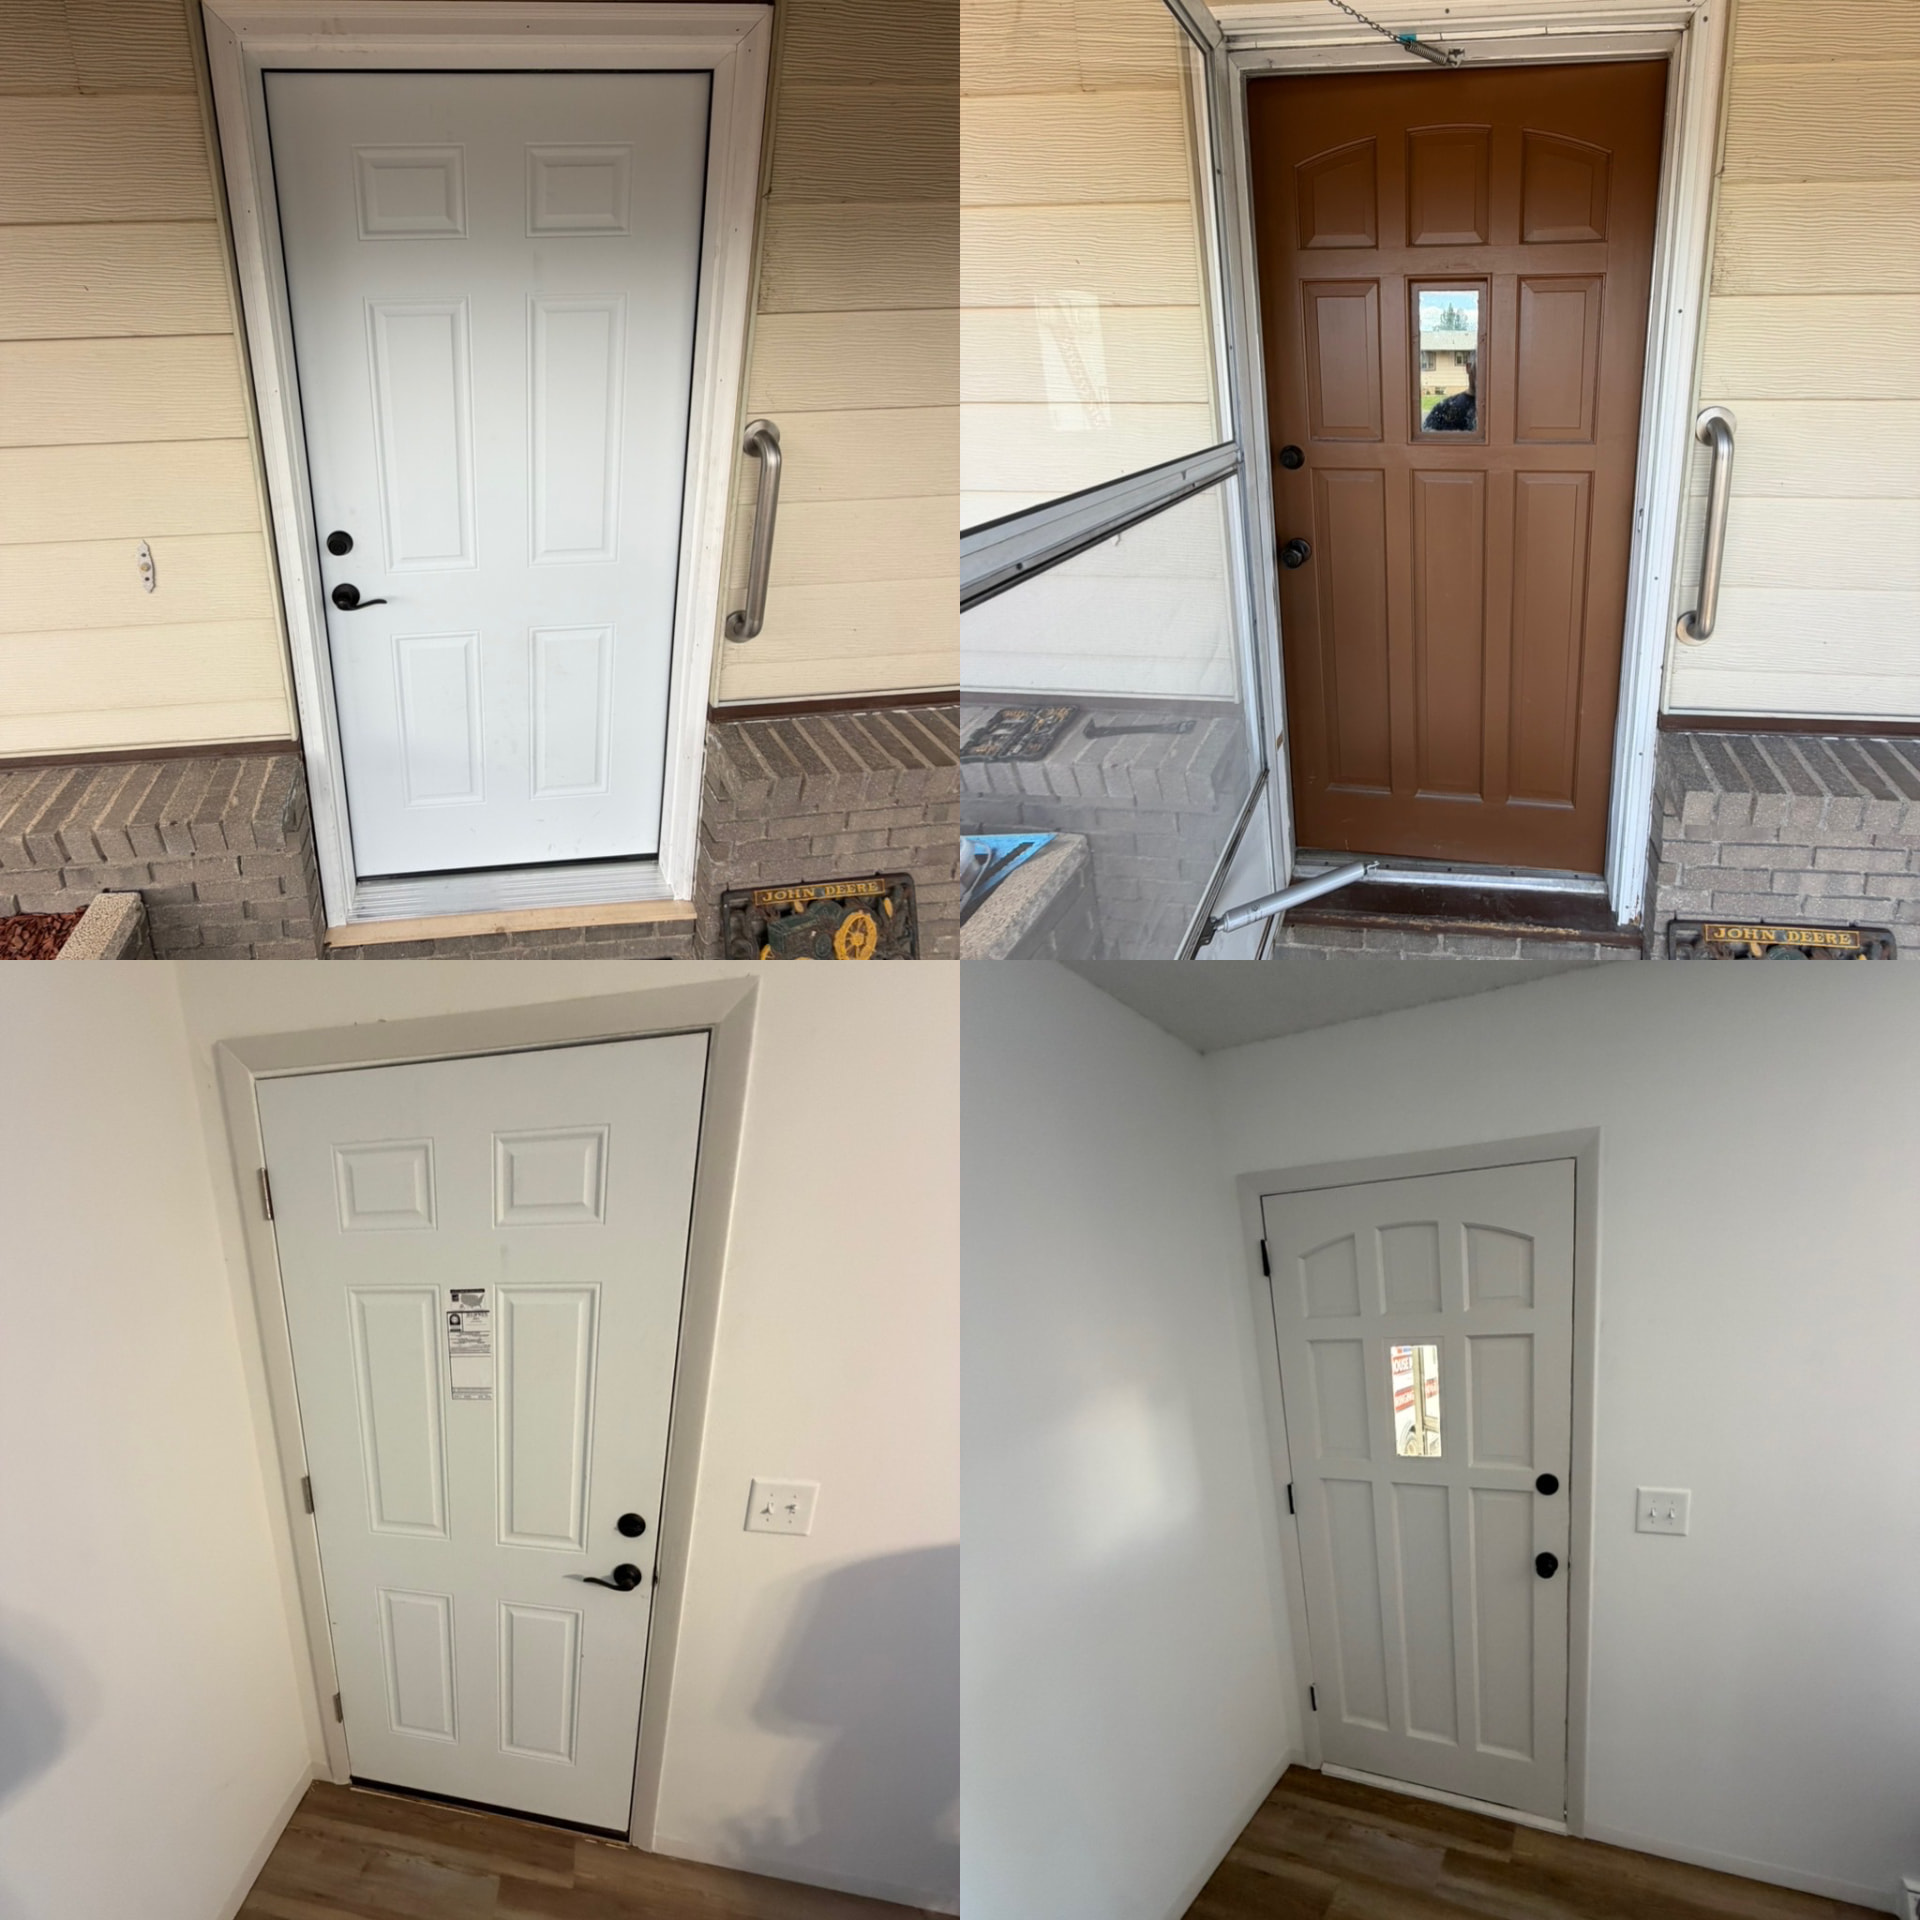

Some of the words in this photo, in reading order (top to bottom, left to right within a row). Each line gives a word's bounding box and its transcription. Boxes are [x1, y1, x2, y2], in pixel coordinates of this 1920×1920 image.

[762, 888, 816, 901] JOHN
[825, 881, 878, 896] DEERE
[1713, 927, 1776, 940] JOHN
[1788, 930, 1851, 945] DEERE
